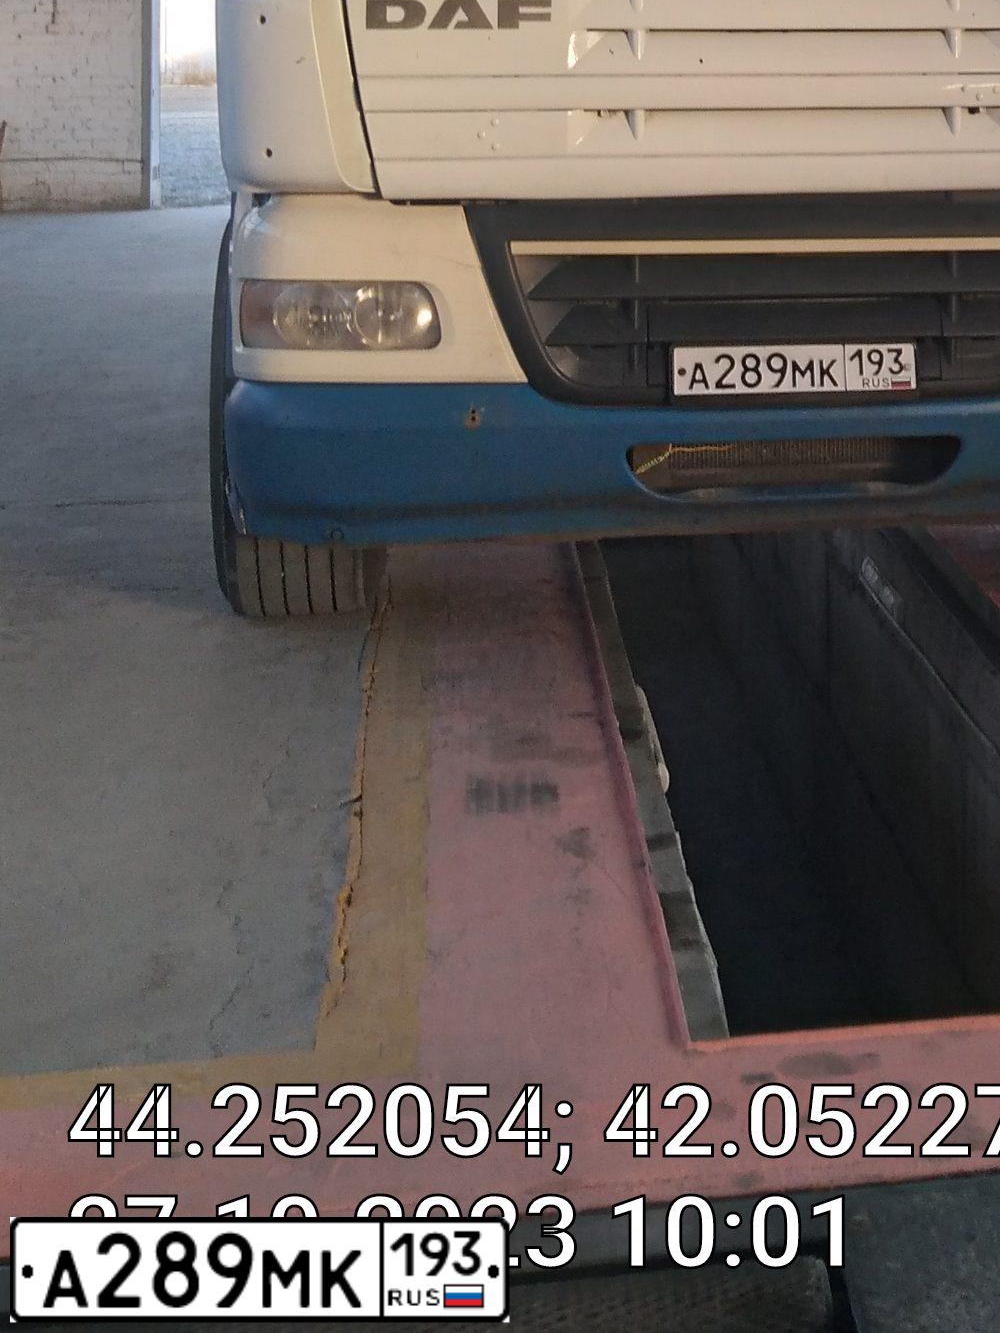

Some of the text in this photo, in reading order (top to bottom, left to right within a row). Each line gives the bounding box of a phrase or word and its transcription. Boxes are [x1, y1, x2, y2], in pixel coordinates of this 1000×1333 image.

[688, 348, 906, 390] A289MK 193
[862, 376, 890, 388] RUS
